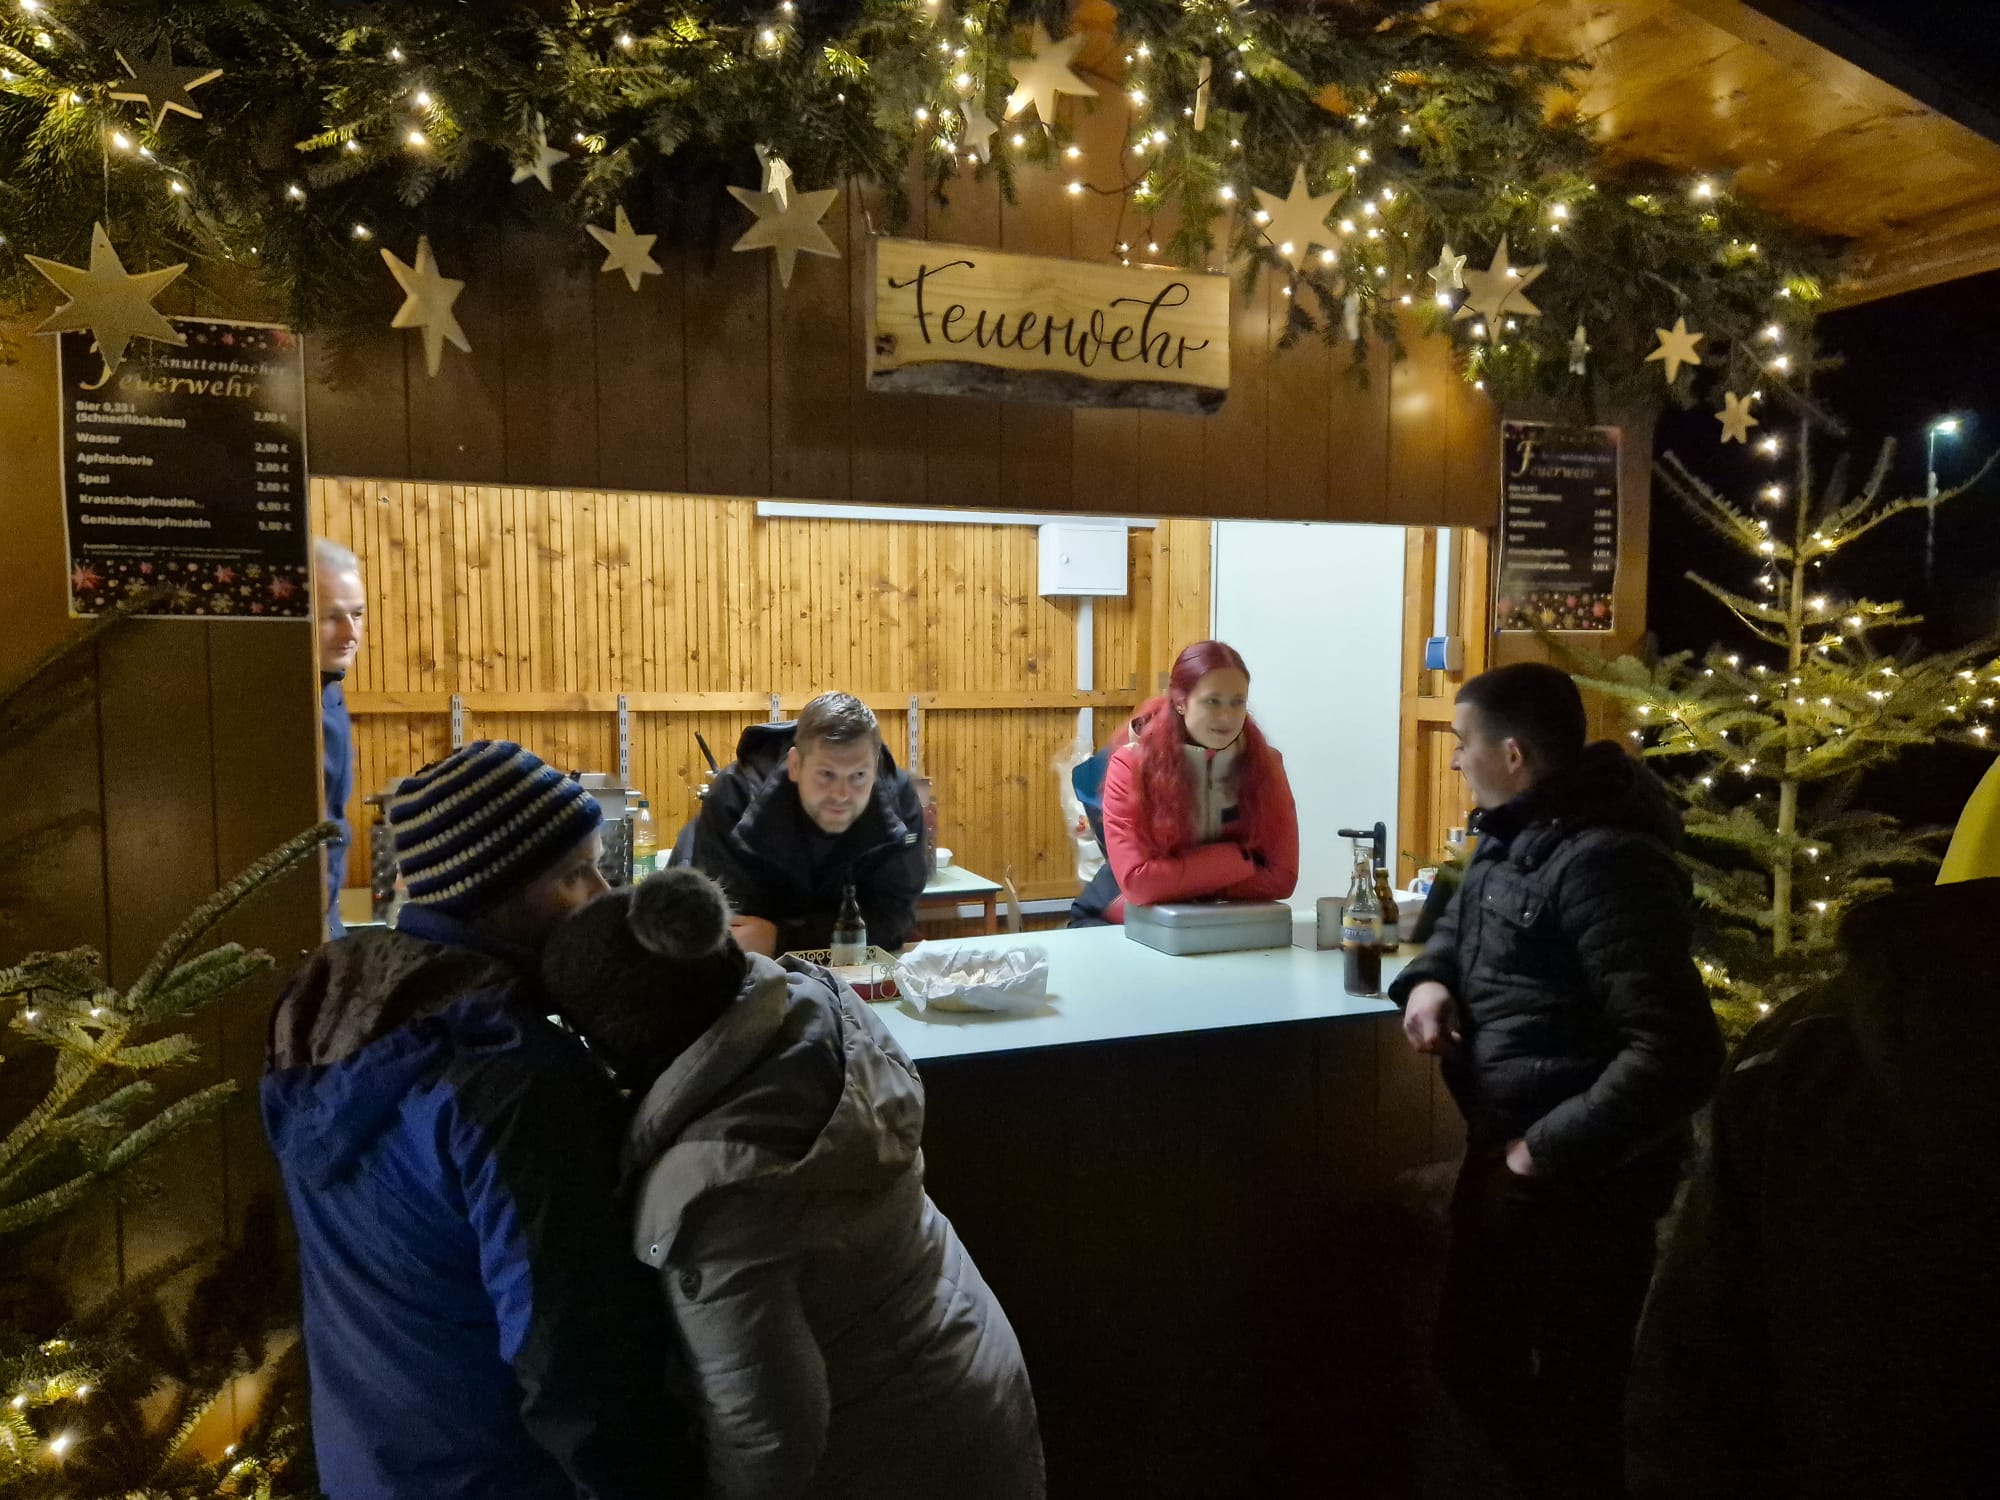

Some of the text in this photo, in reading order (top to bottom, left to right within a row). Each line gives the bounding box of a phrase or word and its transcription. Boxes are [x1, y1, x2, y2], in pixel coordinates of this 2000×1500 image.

[887, 260, 1209, 368] Feuerwehr
[141, 354, 285, 376] hnuttenbacher
[76, 400, 101, 412] Bier
[103, 401, 128, 413] 0,33
[76, 412, 187, 428] (Schneeflöckchen)
[76, 432, 121, 444] Wasser
[77, 452, 154, 466] Apfelschorle
[78, 472, 110, 485] Spezi
[79, 493, 196, 508] Krautschupfnudeln
[80, 514, 211, 529] Gemüseschupfnudeln
